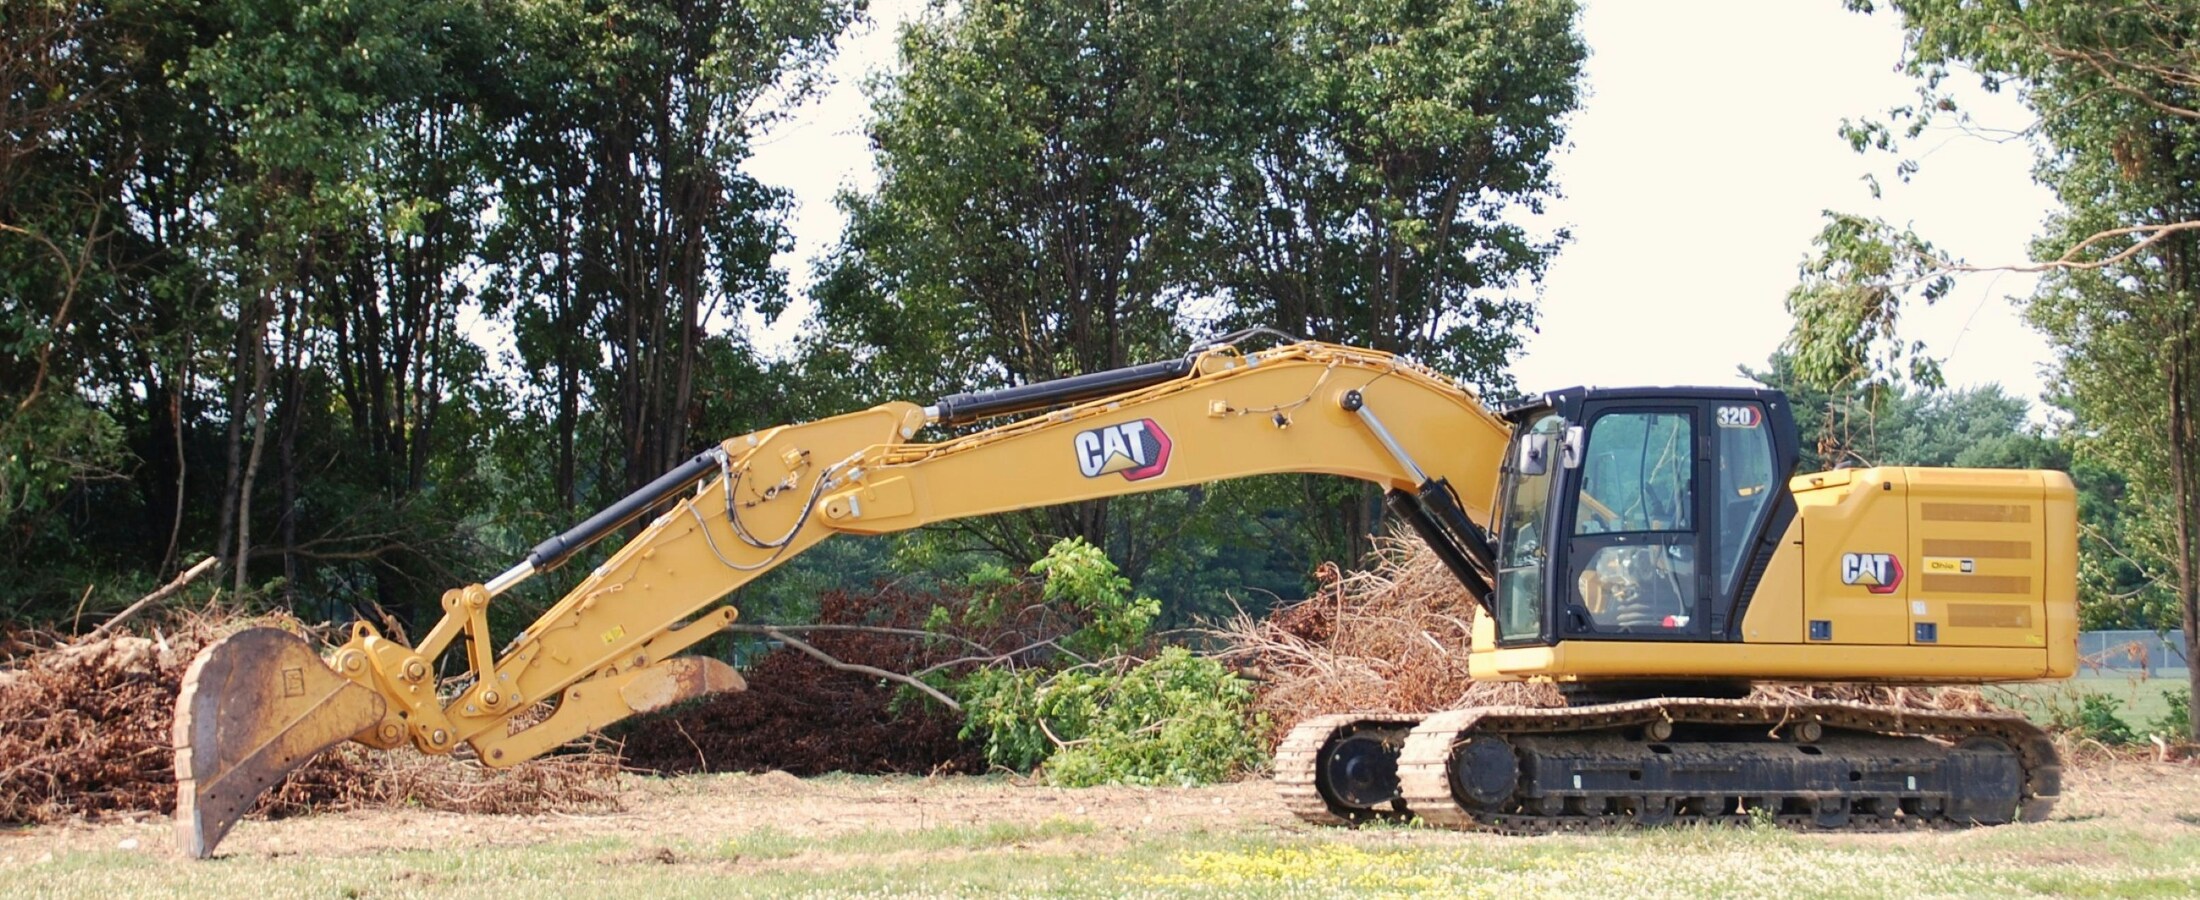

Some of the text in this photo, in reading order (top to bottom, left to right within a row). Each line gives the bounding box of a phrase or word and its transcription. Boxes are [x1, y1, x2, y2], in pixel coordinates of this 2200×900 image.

[1717, 406, 1751, 426] 320
[1075, 420, 1146, 477] CAT
[1842, 553, 1890, 585] CAT
[1931, 561, 1954, 569] Ohio
